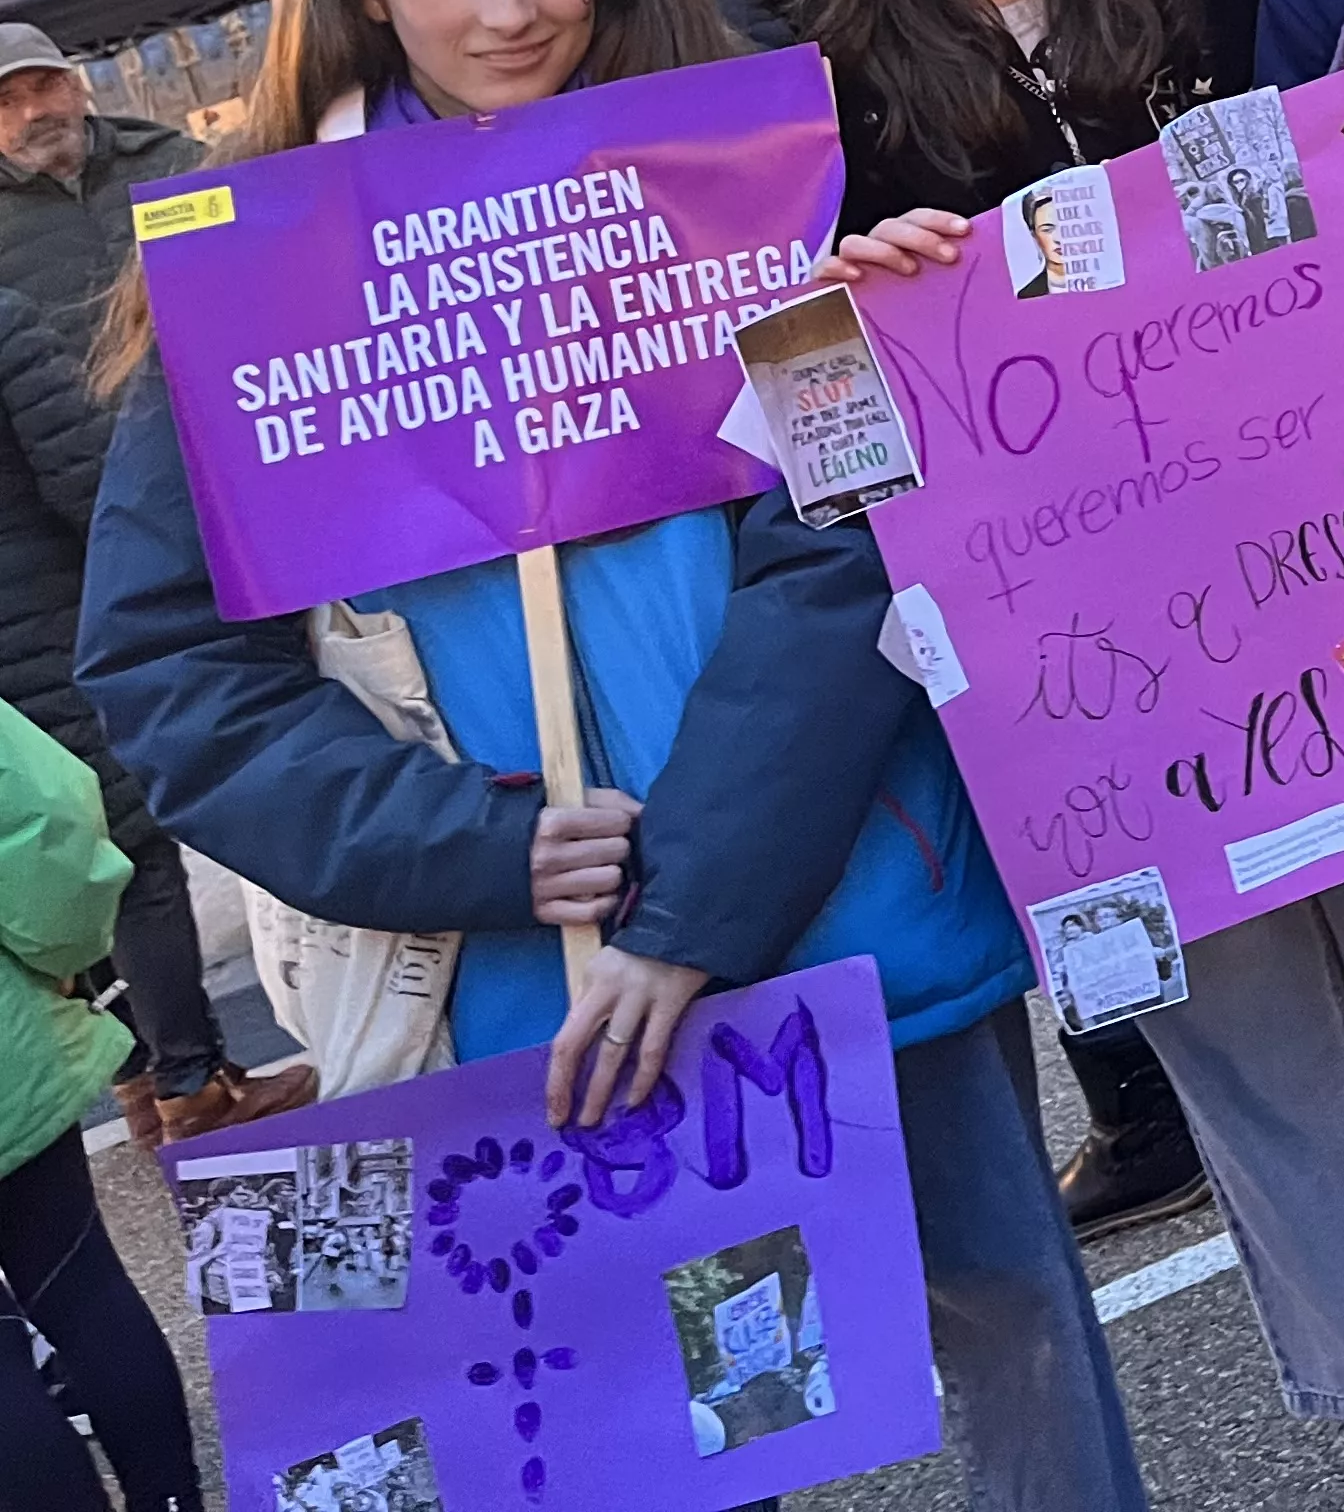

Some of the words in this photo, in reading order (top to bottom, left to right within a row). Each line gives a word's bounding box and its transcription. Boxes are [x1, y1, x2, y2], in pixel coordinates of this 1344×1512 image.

[373, 166, 646, 268] GARANTICEN
[363, 279, 414, 327] LA
[427, 214, 678, 311] ASISTENCIA
[231, 307, 487, 415] SANITARIA
[496, 299, 525, 347] Y
[544, 288, 601, 338] LA
[611, 239, 813, 324] ENTREGA
[255, 410, 324, 466] DE
[339, 376, 490, 446] AYUDA
[473, 418, 505, 468] A
[515, 387, 640, 456] GAZA
[797, 374, 855, 412] SLUT
[1236, 392, 1327, 462] ser
[808, 442, 888, 487] LEGEND
